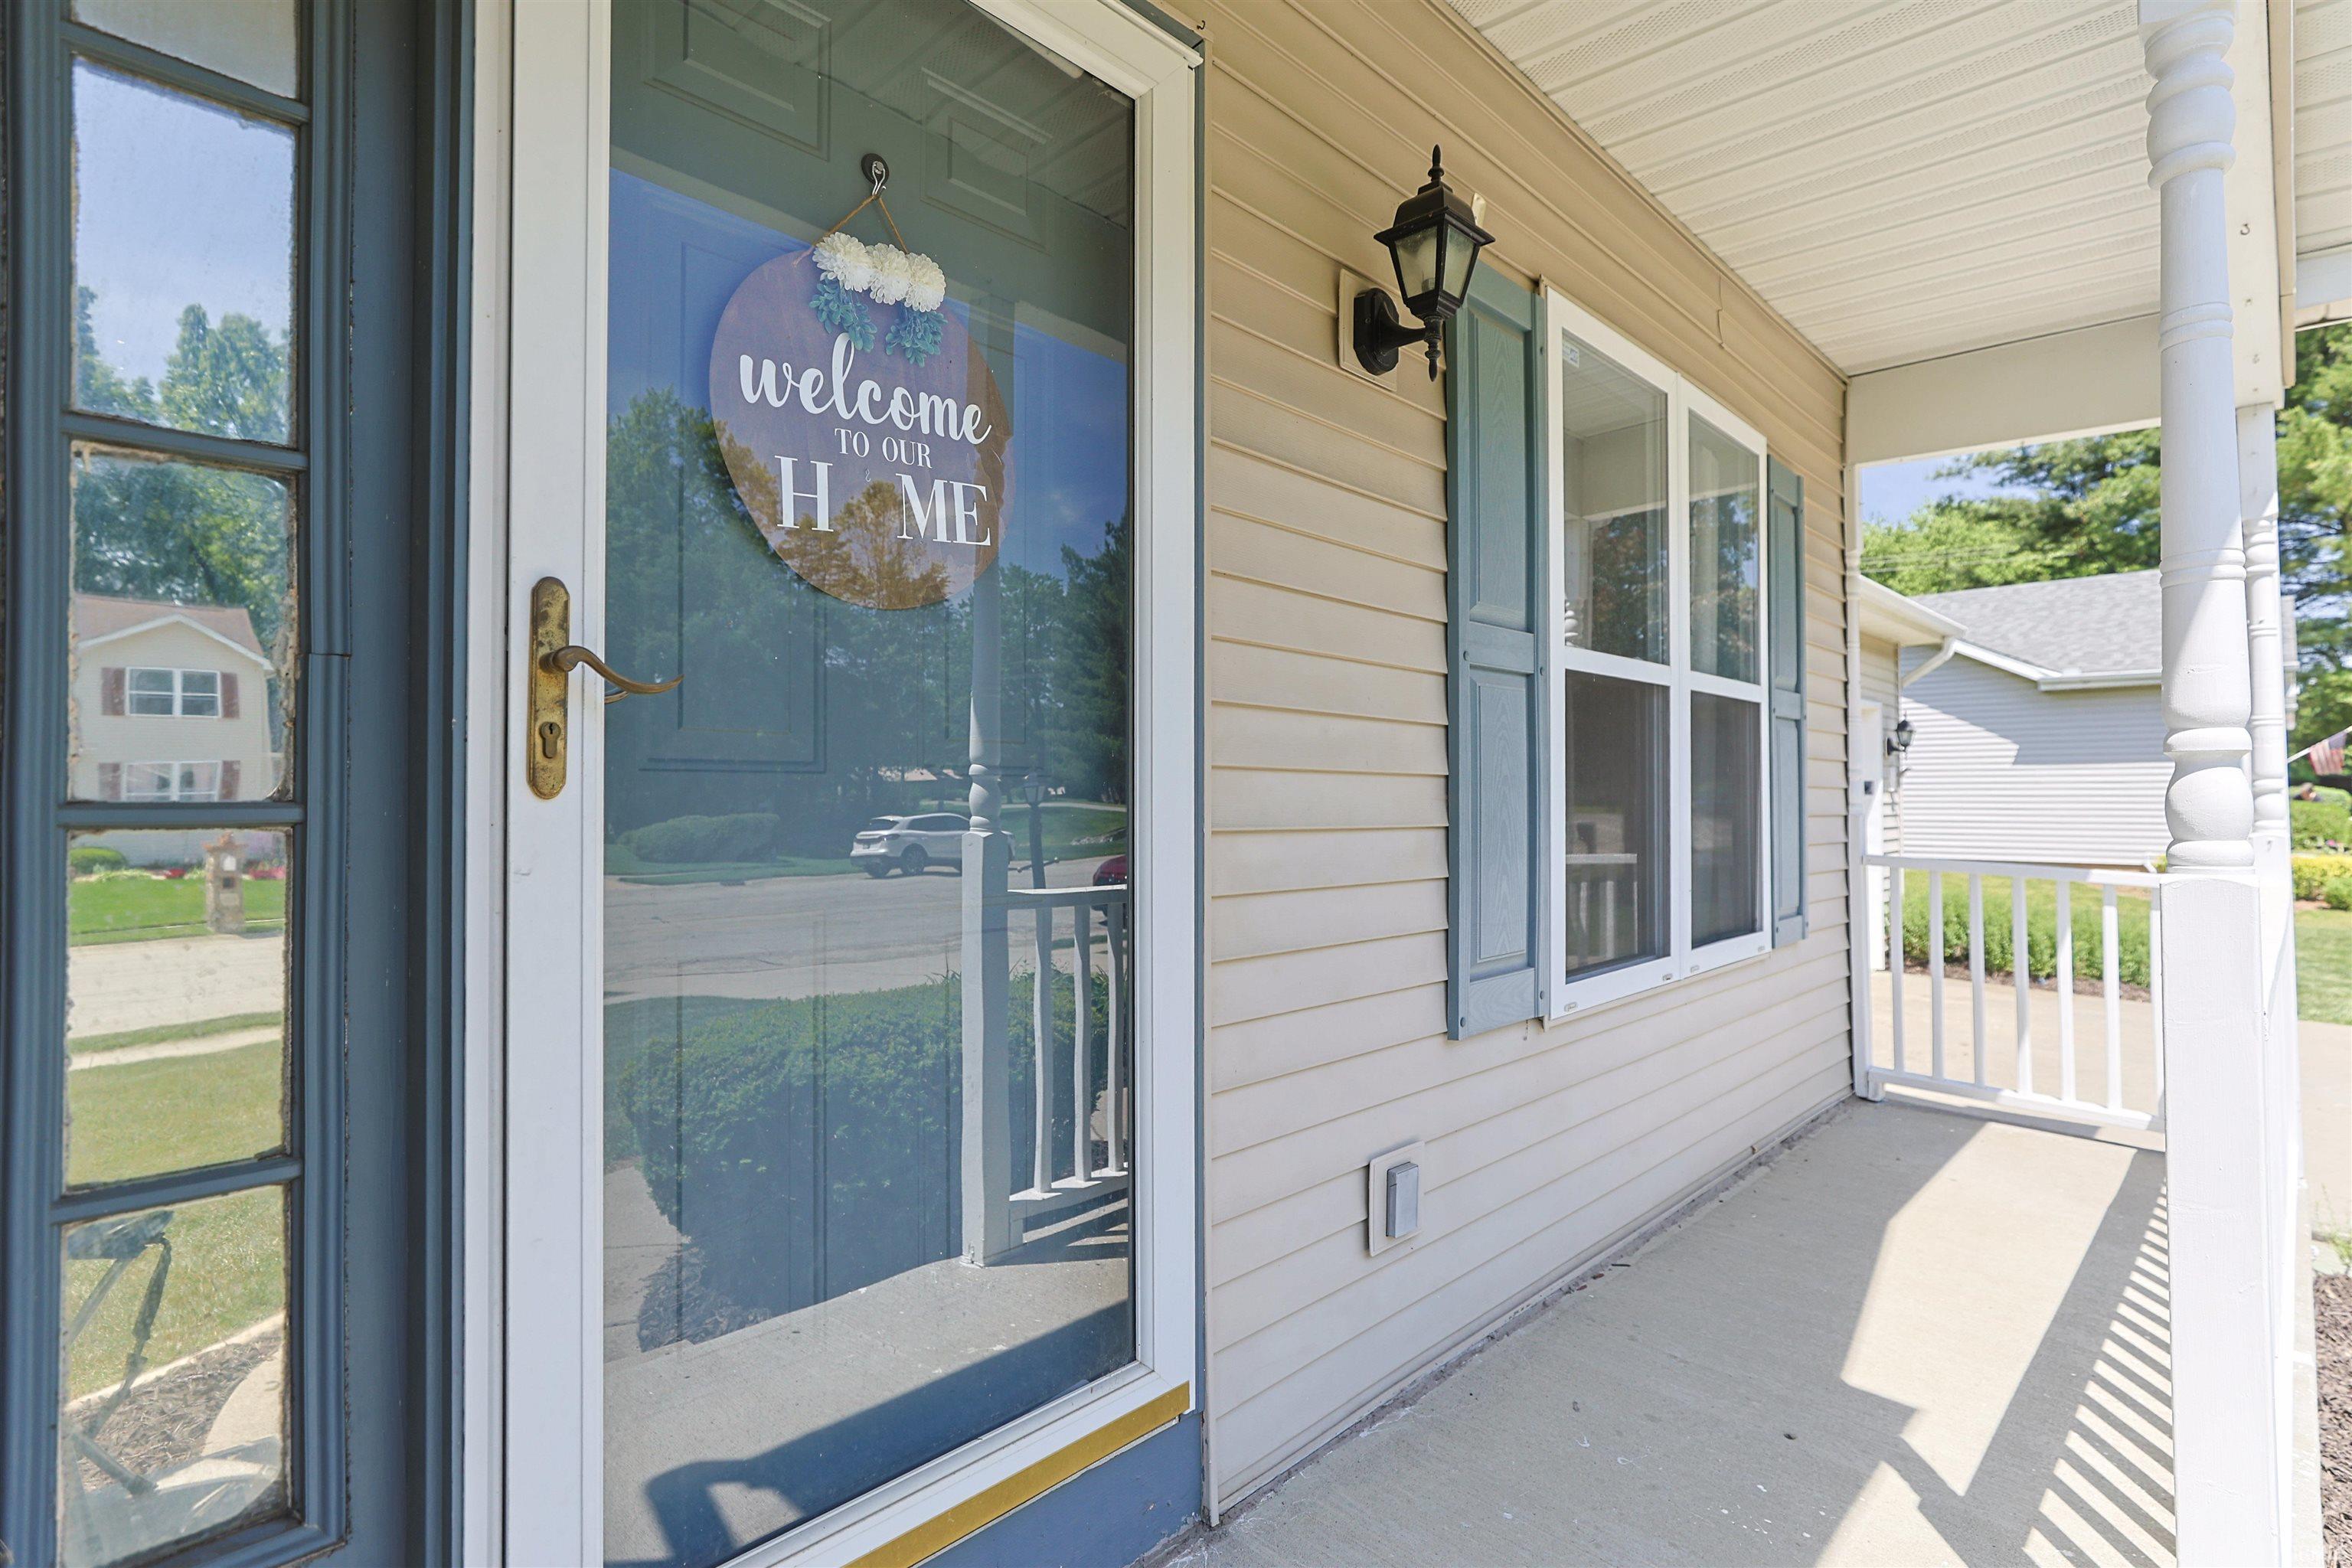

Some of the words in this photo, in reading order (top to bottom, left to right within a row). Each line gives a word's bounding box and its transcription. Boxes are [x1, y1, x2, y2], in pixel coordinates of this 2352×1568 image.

[740, 332, 992, 445] welcome
[835, 428, 870, 458] TO
[882, 436, 933, 469] OUR
